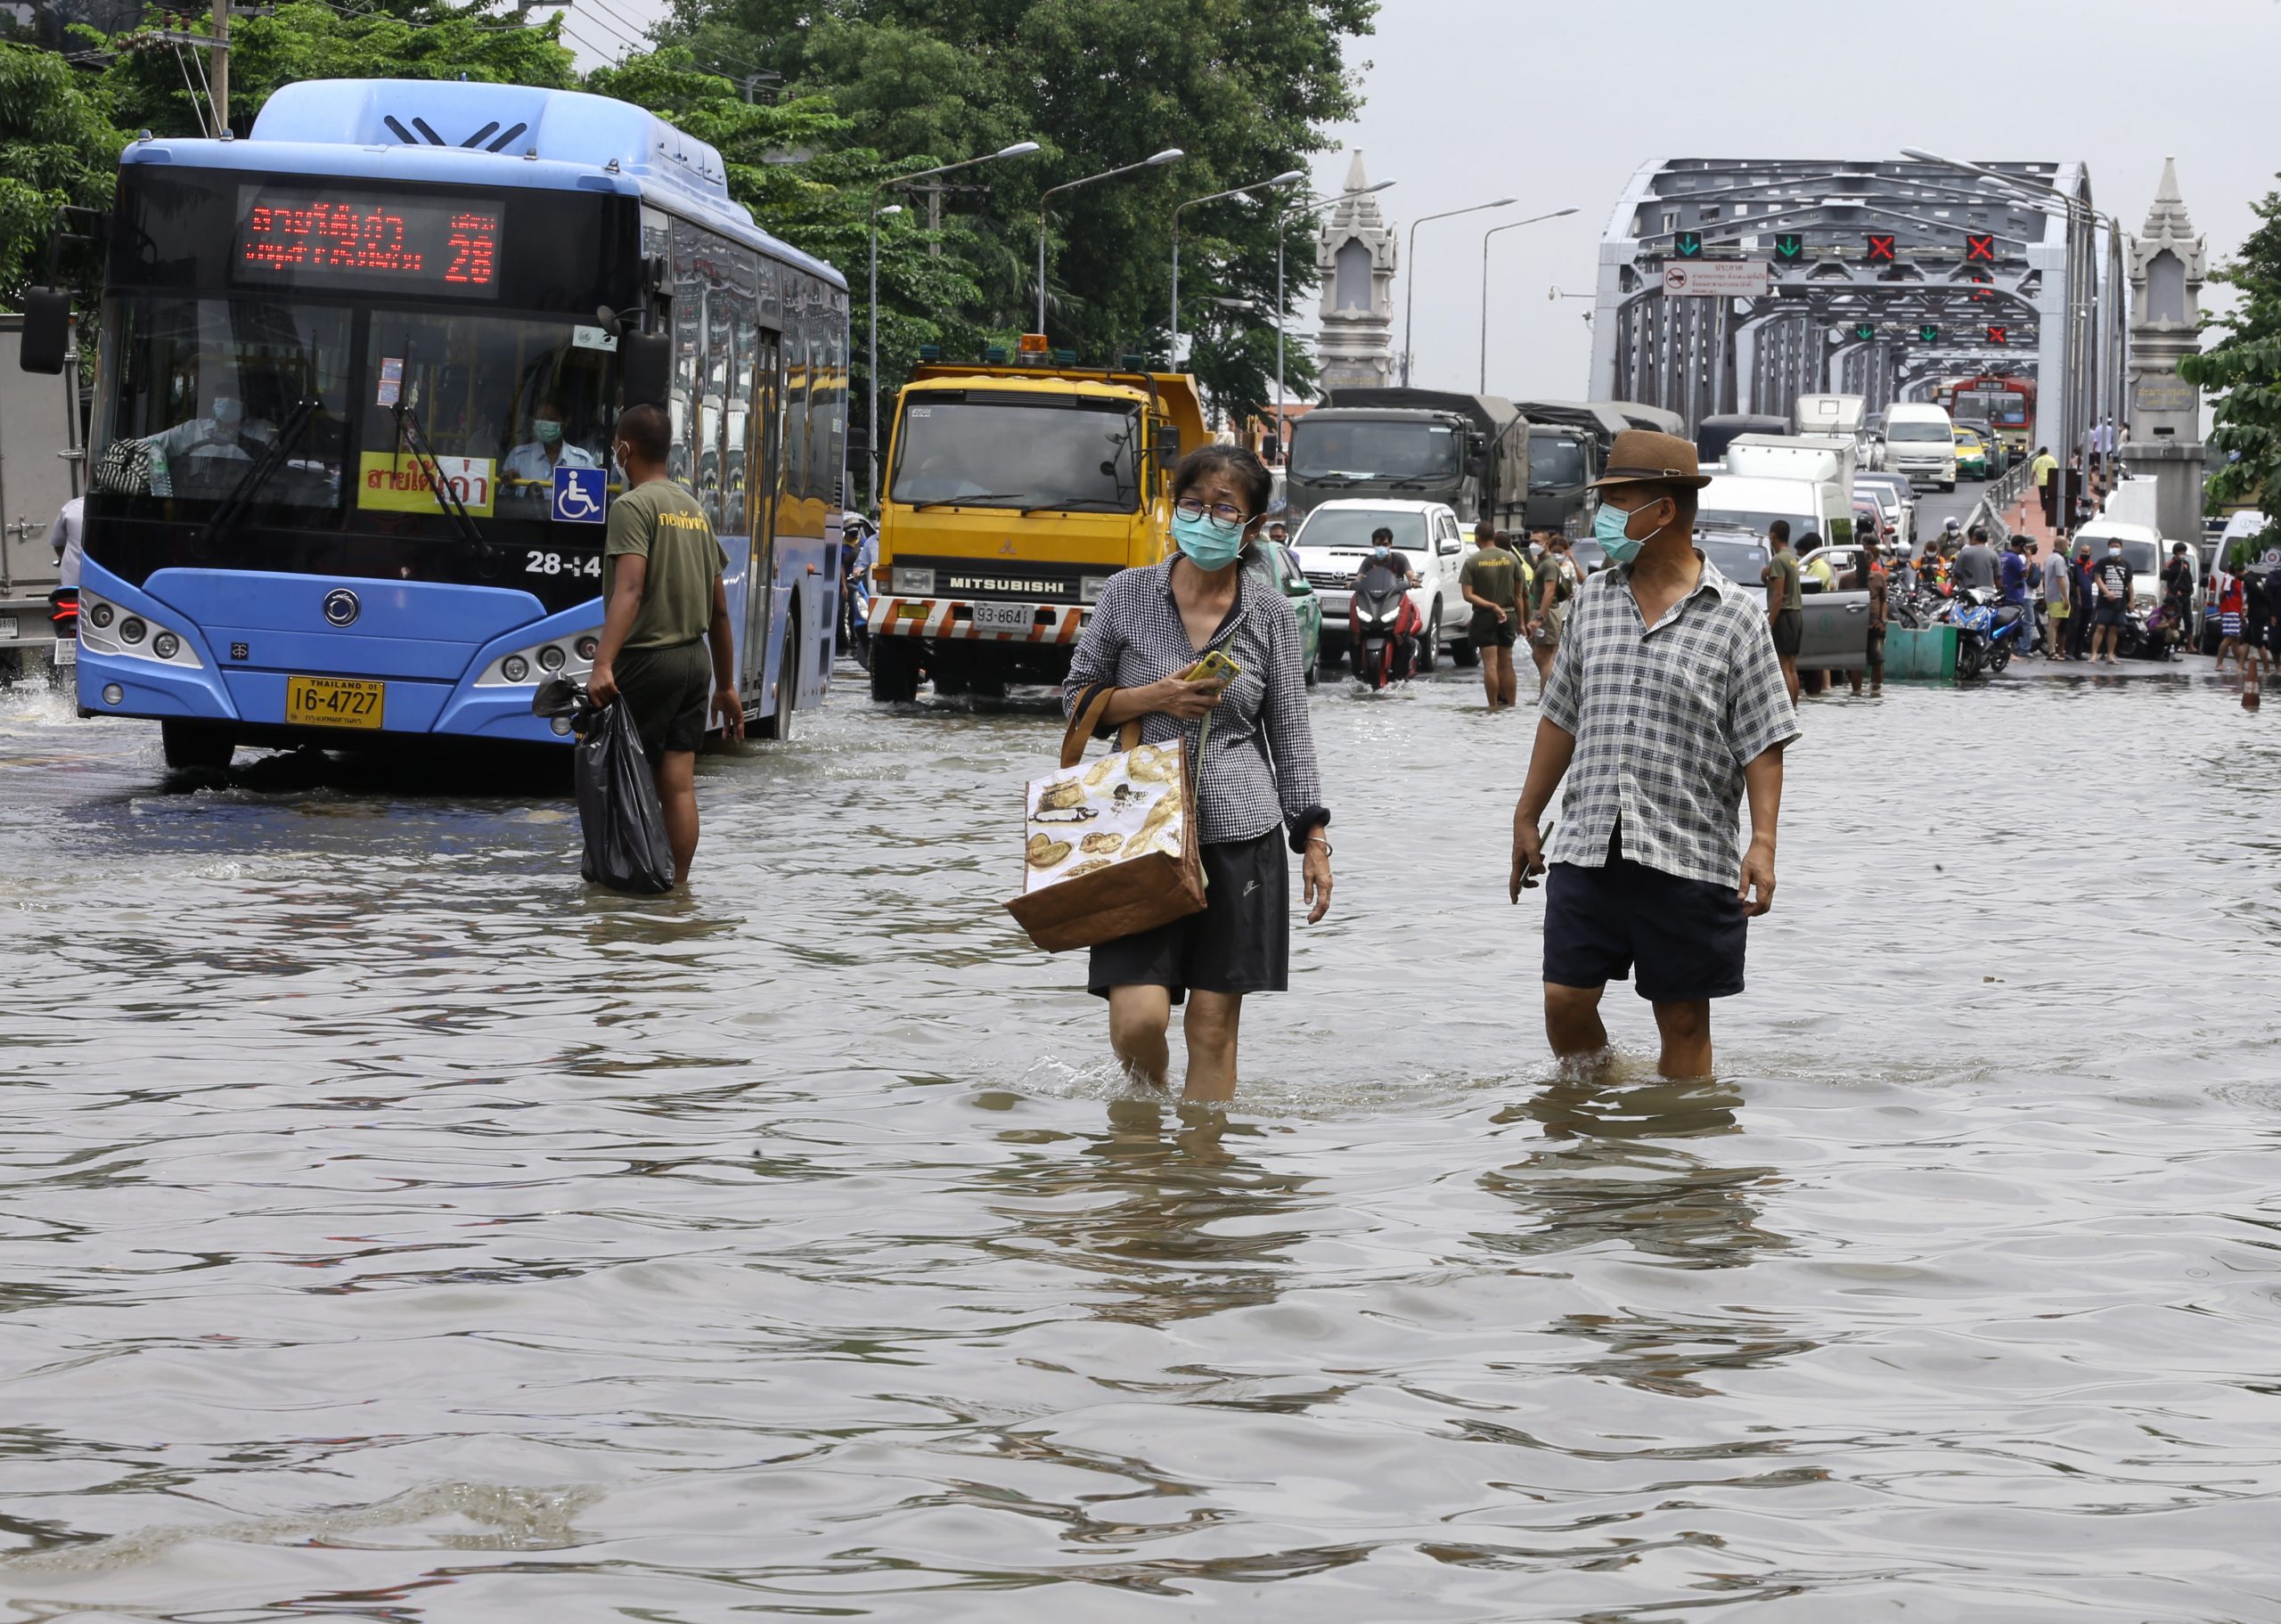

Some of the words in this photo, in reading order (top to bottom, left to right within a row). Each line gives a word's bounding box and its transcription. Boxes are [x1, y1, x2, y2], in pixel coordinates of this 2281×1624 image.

[446, 233, 494, 283] 28
[367, 459, 488, 505] สายใต้เก่า
[950, 577, 1065, 593] MITSUBISHI
[977, 607, 1028, 624] 93-8641
[310, 680, 362, 690] THAILAND
[295, 687, 378, 715] 16-4727
